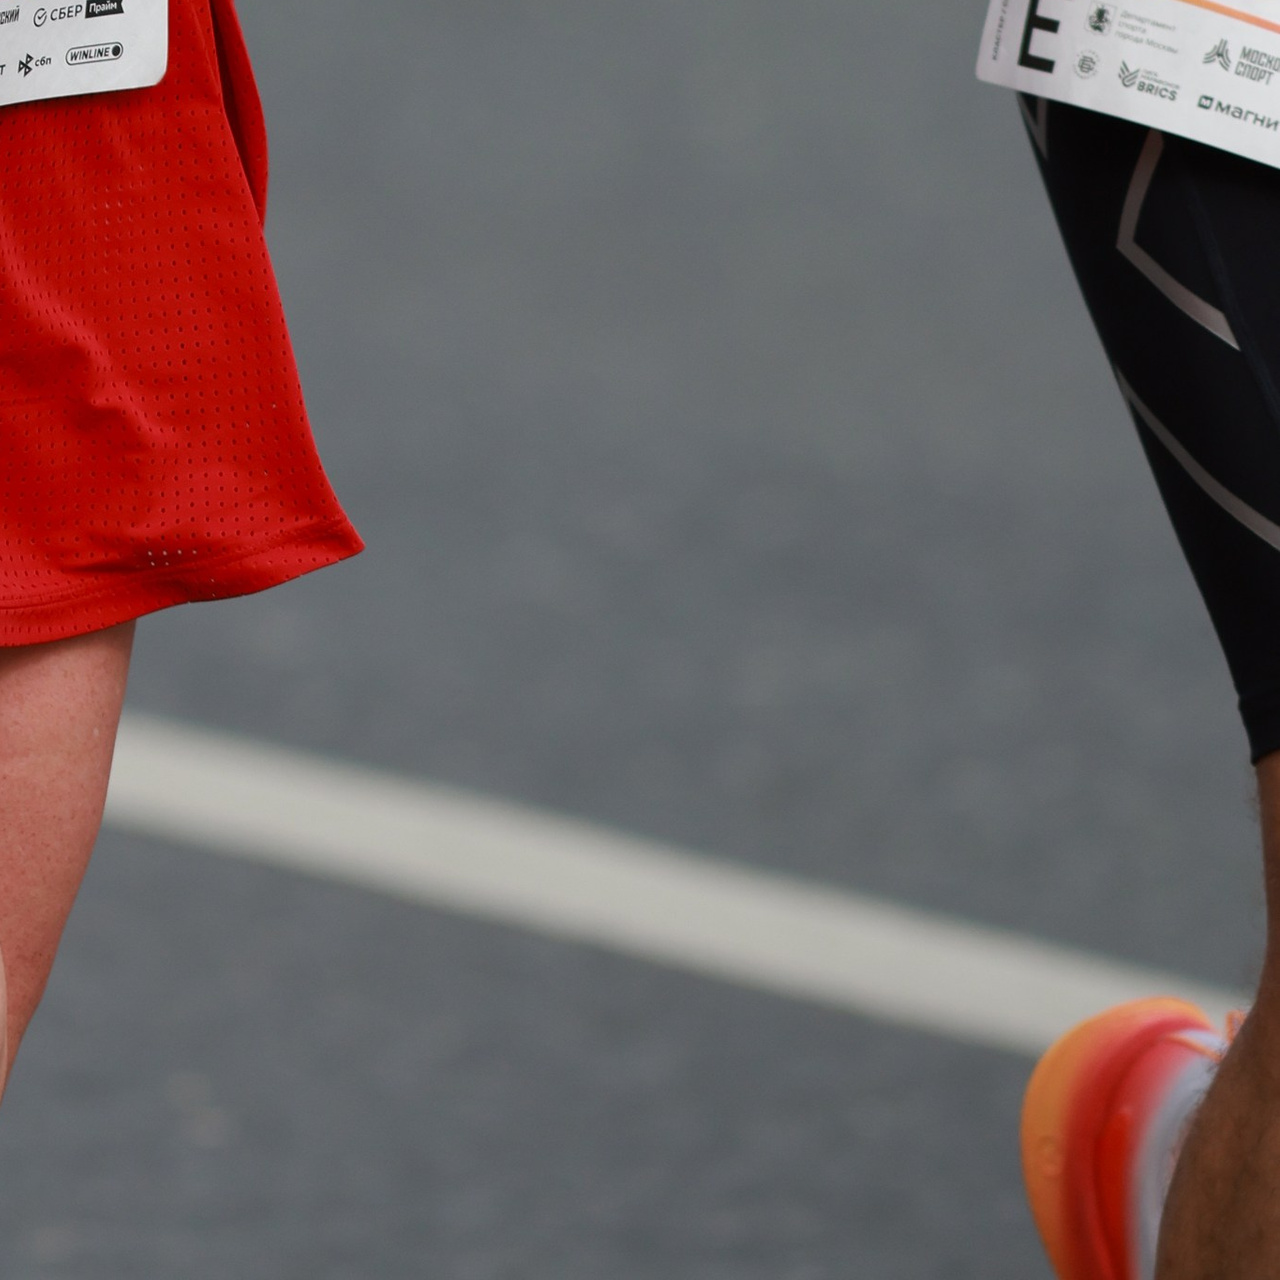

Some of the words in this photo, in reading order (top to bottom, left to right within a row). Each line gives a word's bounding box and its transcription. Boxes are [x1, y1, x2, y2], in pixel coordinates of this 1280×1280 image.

[50, 4, 83, 22] СБЕР
[88, 0, 118, 14] Прайм
[70, 47, 110, 61] WINLINE
[1234, 61, 1274, 86] СПОРТ
[1137, 81, 1178, 101] BRICS
